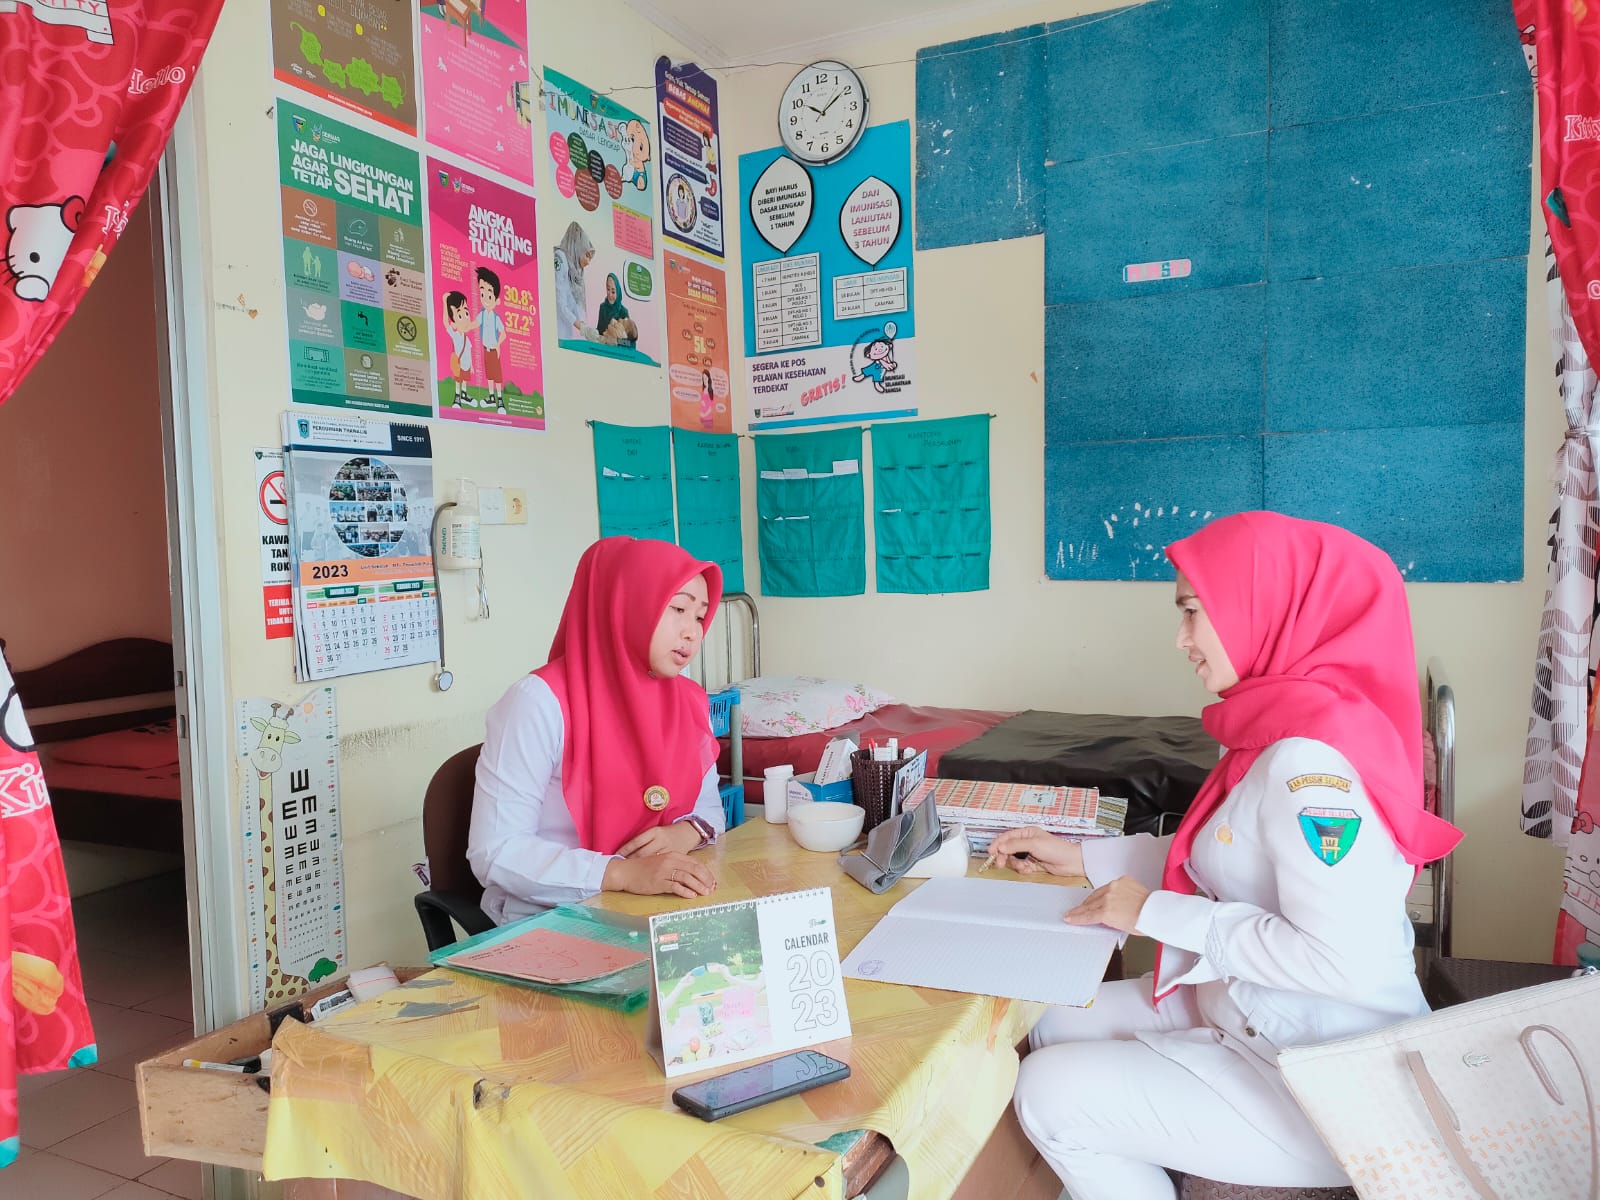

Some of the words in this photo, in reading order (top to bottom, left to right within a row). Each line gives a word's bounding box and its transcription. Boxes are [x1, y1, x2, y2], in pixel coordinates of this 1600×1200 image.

[816, 74, 828, 85] 12
[802, 84, 810, 94] 11
[844, 86, 852, 95] 2
[792, 99, 804, 110] 10
[850, 101, 858, 111] 3
[550, 94, 620, 143] IMUNISASI
[790, 116, 798, 126] 9
[846, 119, 853, 128] 4
[796, 131, 803, 140] 8
[836, 135, 844, 144] 5
[807, 142, 814, 151] 7
[821, 143, 829, 153] 6
[291, 139, 328, 163] JAGA
[330, 152, 413, 192] LINGKUNGAN
[293, 154, 330, 177] AGAR
[291, 167, 333, 190] TETAP
[334, 169, 414, 216] SEHAT
[778, 184, 798, 193] HARUS
[862, 190, 880, 199] DAN
[758, 197, 776, 206] DIBERI
[776, 191, 807, 203] IMUNISASI
[760, 206, 778, 215] DASAR
[779, 201, 805, 211] LENGKAP
[850, 200, 893, 213] IMUNISASI
[469, 204, 514, 234] ANGKA
[769, 211, 795, 222] SEBELUM
[852, 212, 892, 225] LANJUTAN
[775, 221, 795, 229] TAHUN
[853, 226, 890, 237] SEBELUM
[469, 221, 533, 256] STUNTING
[862, 238, 890, 248] TAHUN
[469, 236, 514, 266] TURUN
[752, 362, 780, 372] SEGERA
[781, 360, 790, 368] KE
[791, 358, 806, 367] POS
[753, 374, 784, 384] PELAYAN
[785, 368, 827, 380] KESEHATAN
[753, 384, 789, 395] TERDEKAT
[800, 374, 847, 407] GRATIS!
[312, 565, 349, 579] 2023
[784, 932, 830, 951] CALENDAR
[787, 950, 835, 993] 20
[792, 989, 839, 1033] 23
